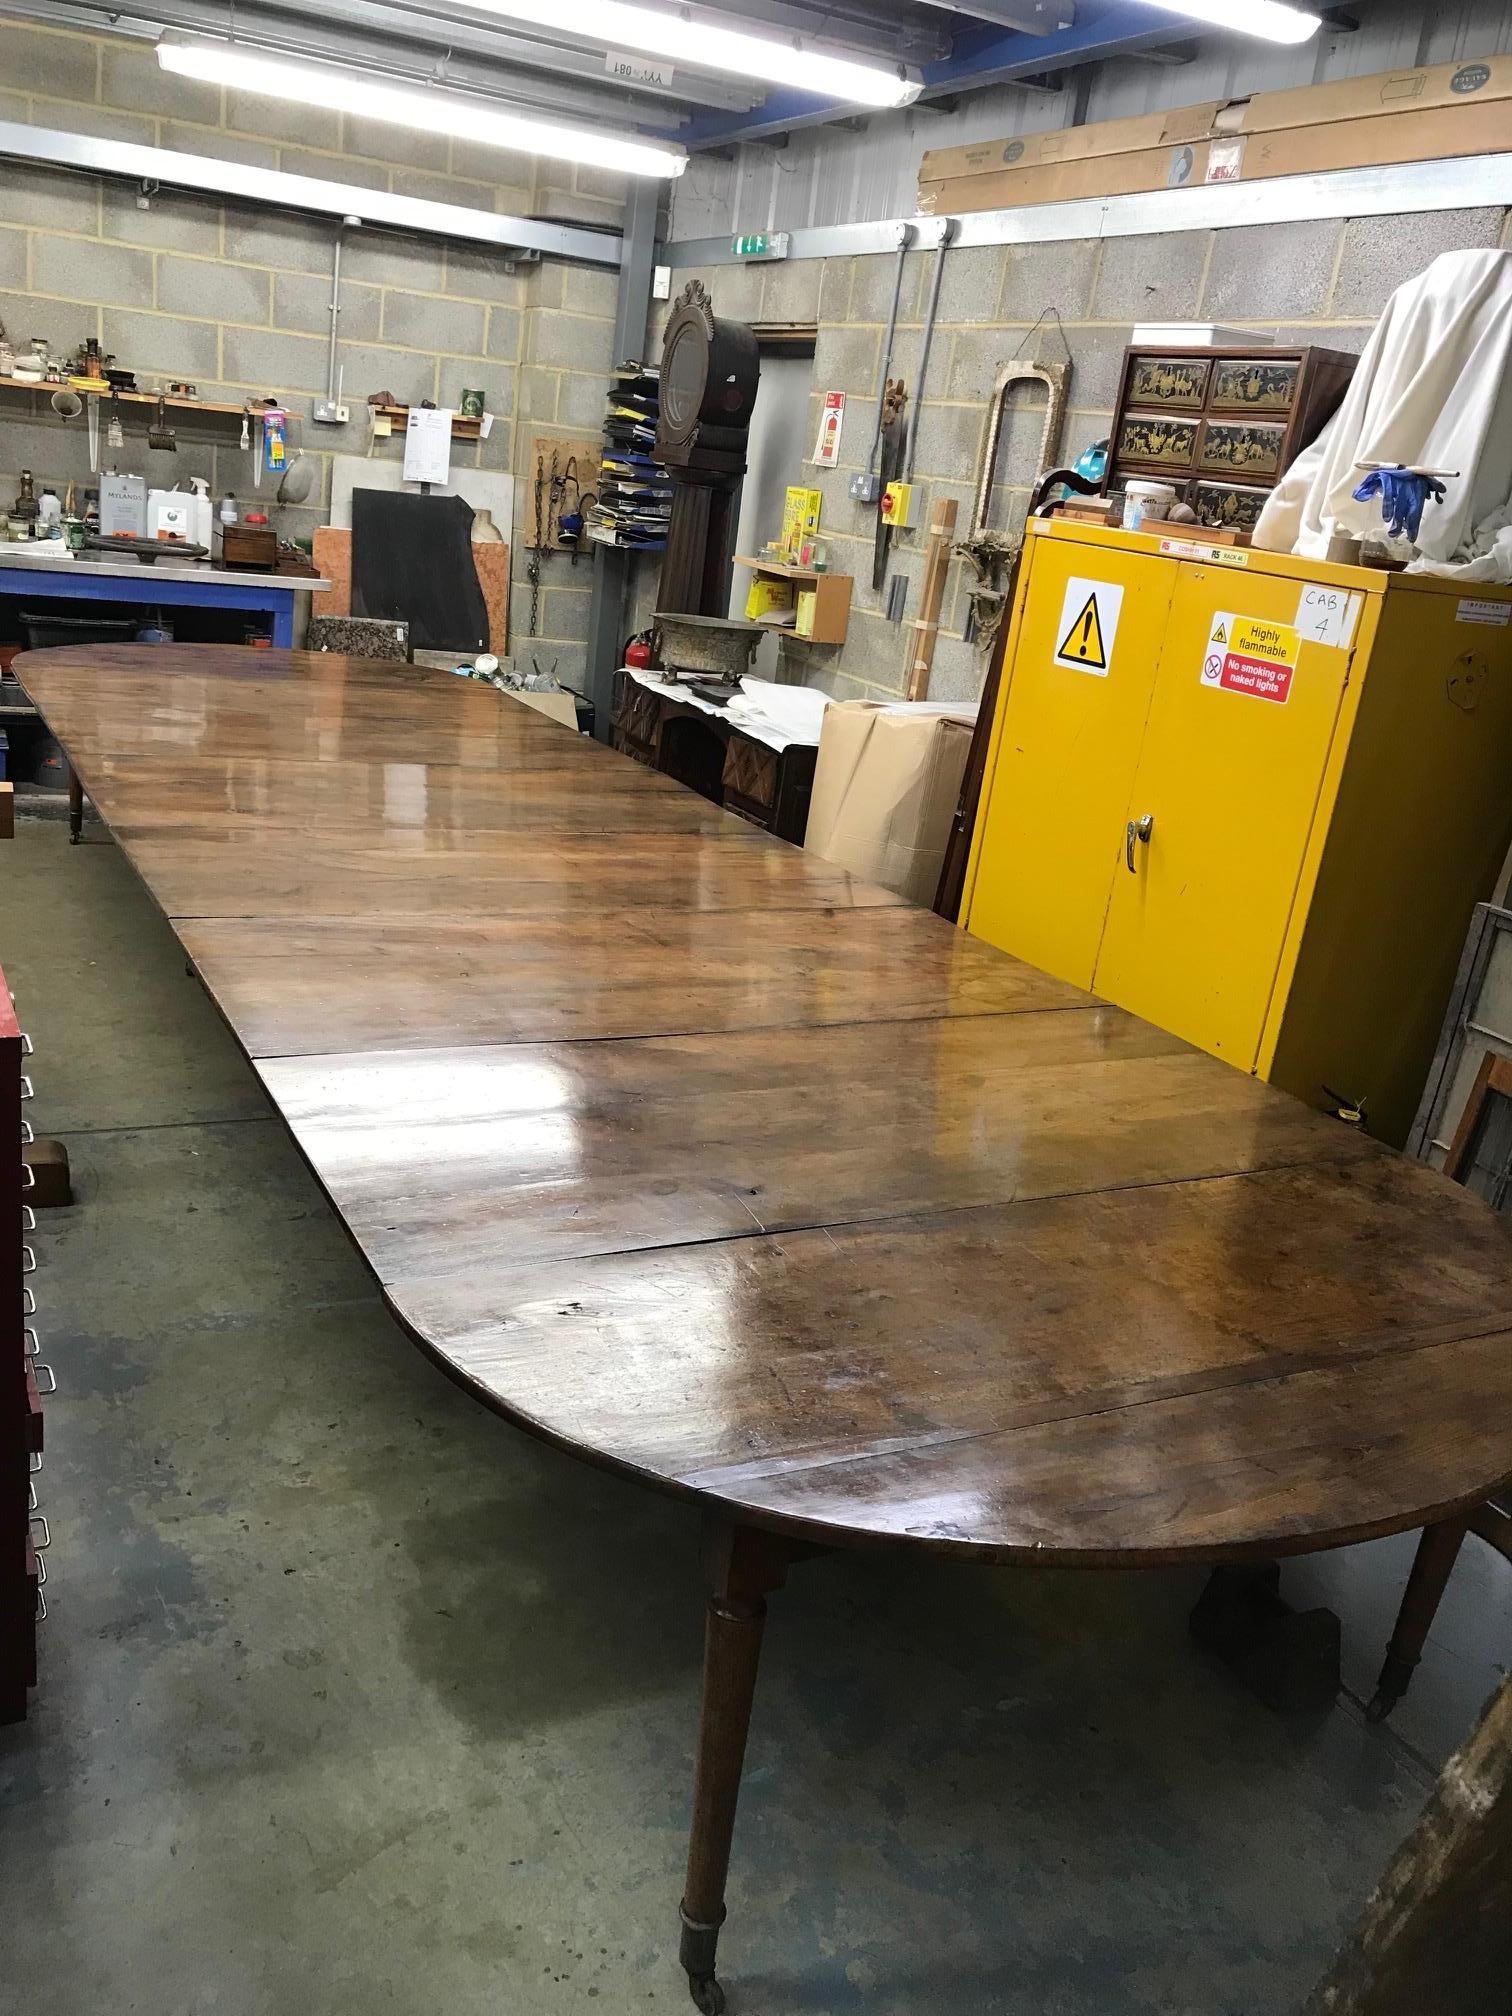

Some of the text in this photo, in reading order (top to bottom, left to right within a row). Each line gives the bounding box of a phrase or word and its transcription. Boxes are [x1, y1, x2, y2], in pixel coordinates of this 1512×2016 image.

[108, 492, 143, 501] MYLANDS
[1211, 550, 1221, 559] RS
[1305, 590, 1338, 611] CAB
[1250, 625, 1281, 644] Highly
[1314, 618, 1329, 641] 4
[1239, 637, 1287, 658] flammable
[1228, 658, 1288, 682] No smoking or
[1230, 671, 1280, 693] naked lights
